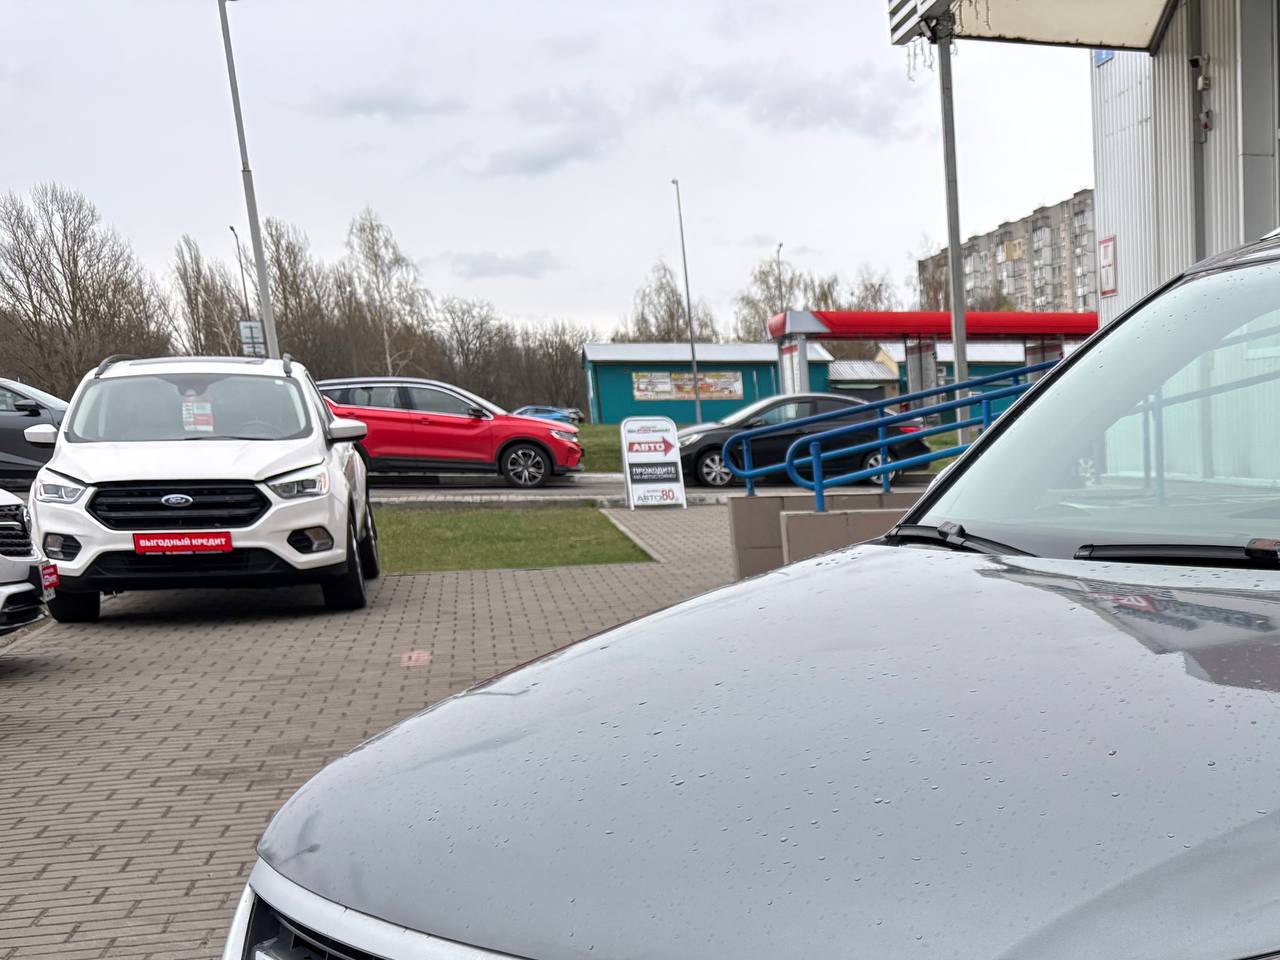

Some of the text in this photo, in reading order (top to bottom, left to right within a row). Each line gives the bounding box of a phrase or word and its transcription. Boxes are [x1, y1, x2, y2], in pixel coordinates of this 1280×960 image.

[632, 442, 665, 452] АВТО
[632, 466, 676, 475] ПРОХОДИТЕ
[139, 537, 226, 547] ВЫГОДНЫЙ КРЕДИТ
